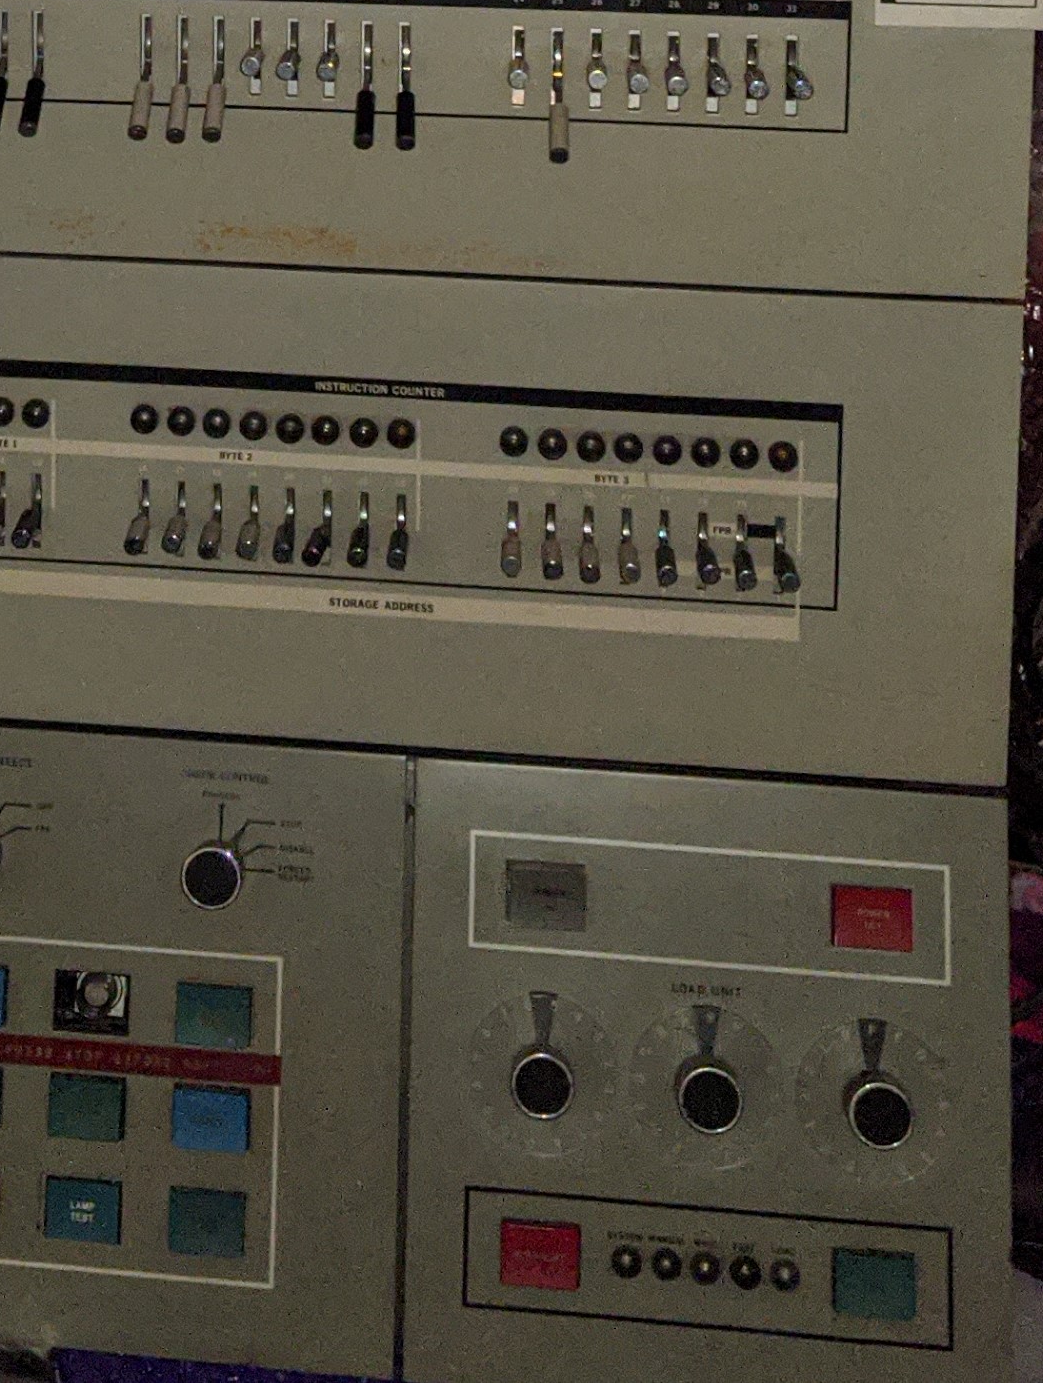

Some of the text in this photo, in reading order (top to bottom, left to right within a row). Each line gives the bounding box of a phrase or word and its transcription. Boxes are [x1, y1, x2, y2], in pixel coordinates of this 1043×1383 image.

[314, 380, 444, 399] INSTRUCTION COUNTER
[218, 449, 253, 462] BYTE 2
[593, 473, 618, 484] BYTE
[712, 526, 731, 536] FPR
[329, 596, 434, 613] STORAGE ADDRESS
[69, 1200, 96, 1211] LAMP
[71, 1211, 96, 1223] TEST
